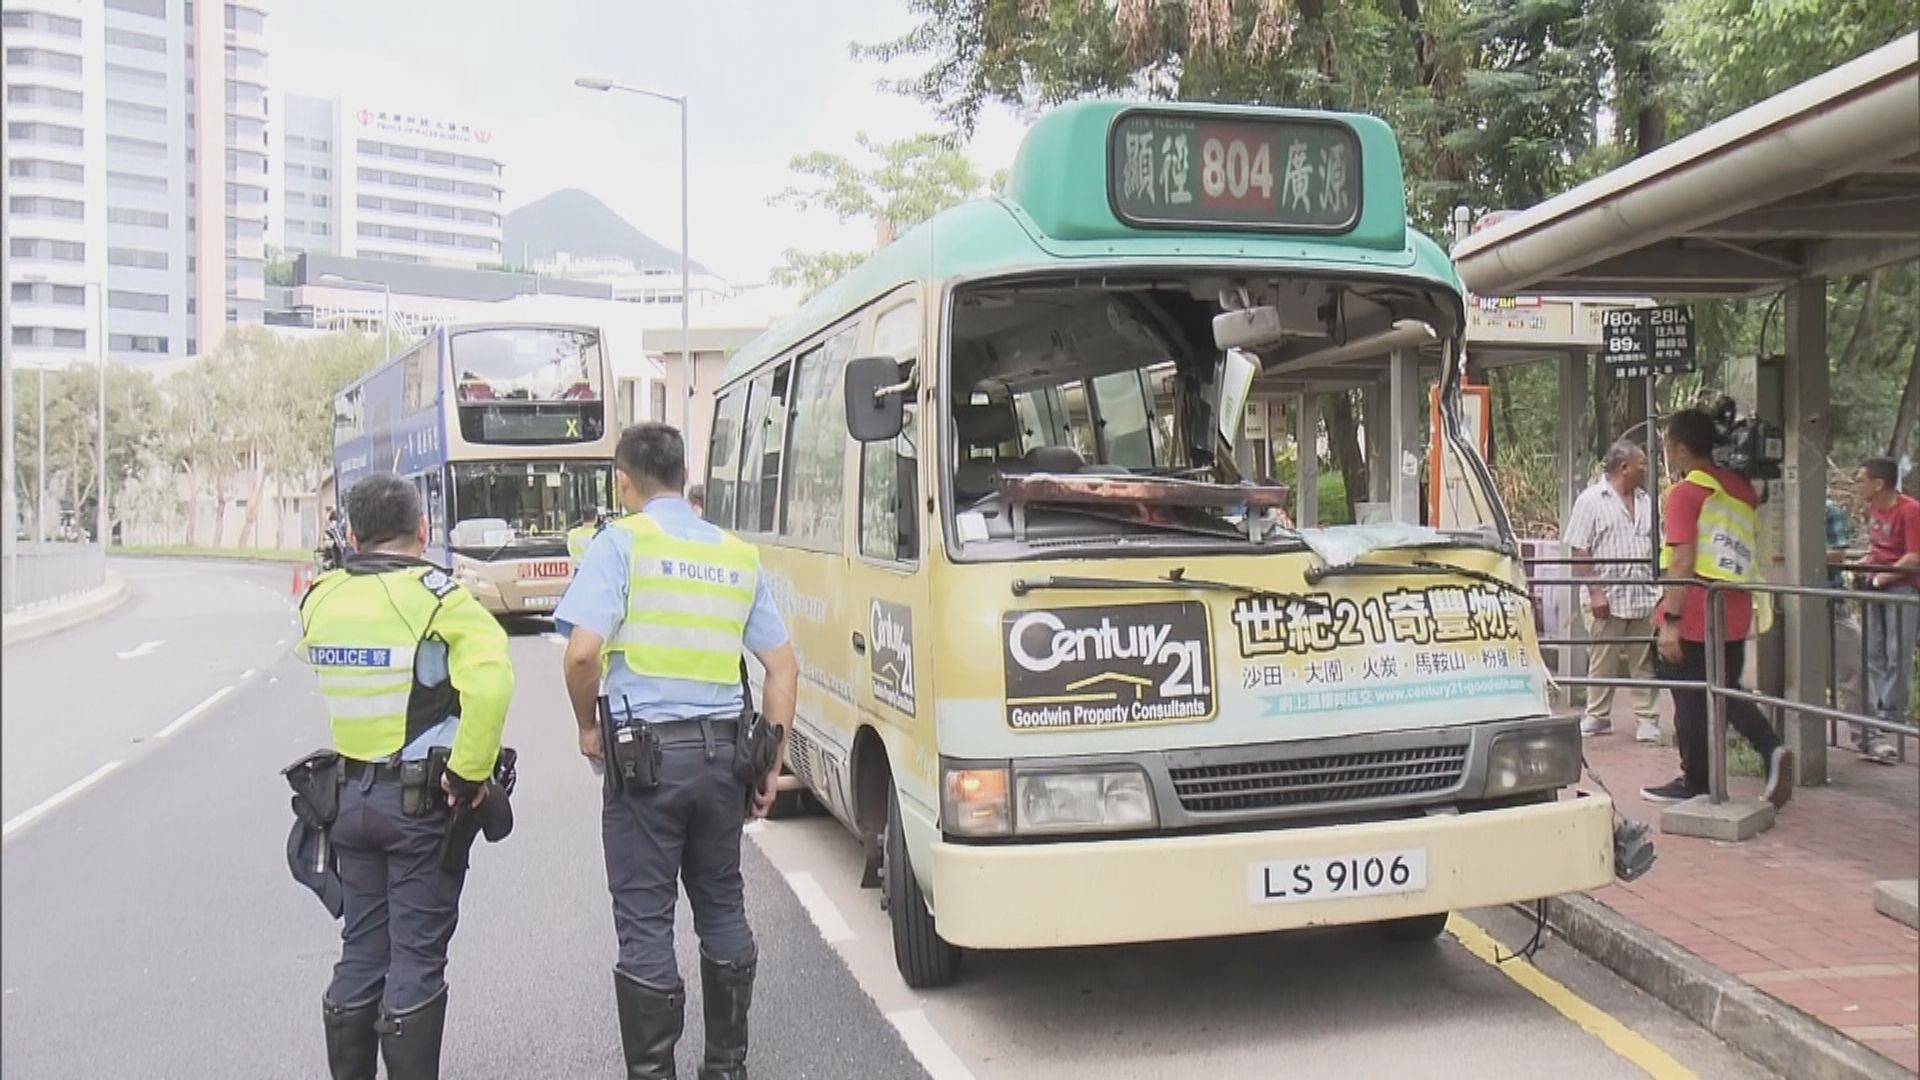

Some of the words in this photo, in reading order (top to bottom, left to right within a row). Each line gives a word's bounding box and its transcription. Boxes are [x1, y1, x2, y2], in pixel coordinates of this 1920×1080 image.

[1123, 130, 1192, 205] 顯徑
[1202, 137, 1274, 200] 804
[1282, 140, 1348, 213] 廣源
[1650, 308, 1688, 325] 281A
[1610, 336, 1641, 352] 89X
[565, 419, 579, 437] X
[533, 561, 569, 578] KMB
[679, 561, 725, 583] POLICE
[1009, 611, 1172, 672] Century
[318, 648, 368, 665] POLICE
[1012, 708, 1071, 728] Goodwin
[1073, 704, 1129, 727] Property
[1131, 698, 1206, 720] Consultants
[1264, 863, 1313, 899] LS
[1325, 855, 1410, 893] 9106
